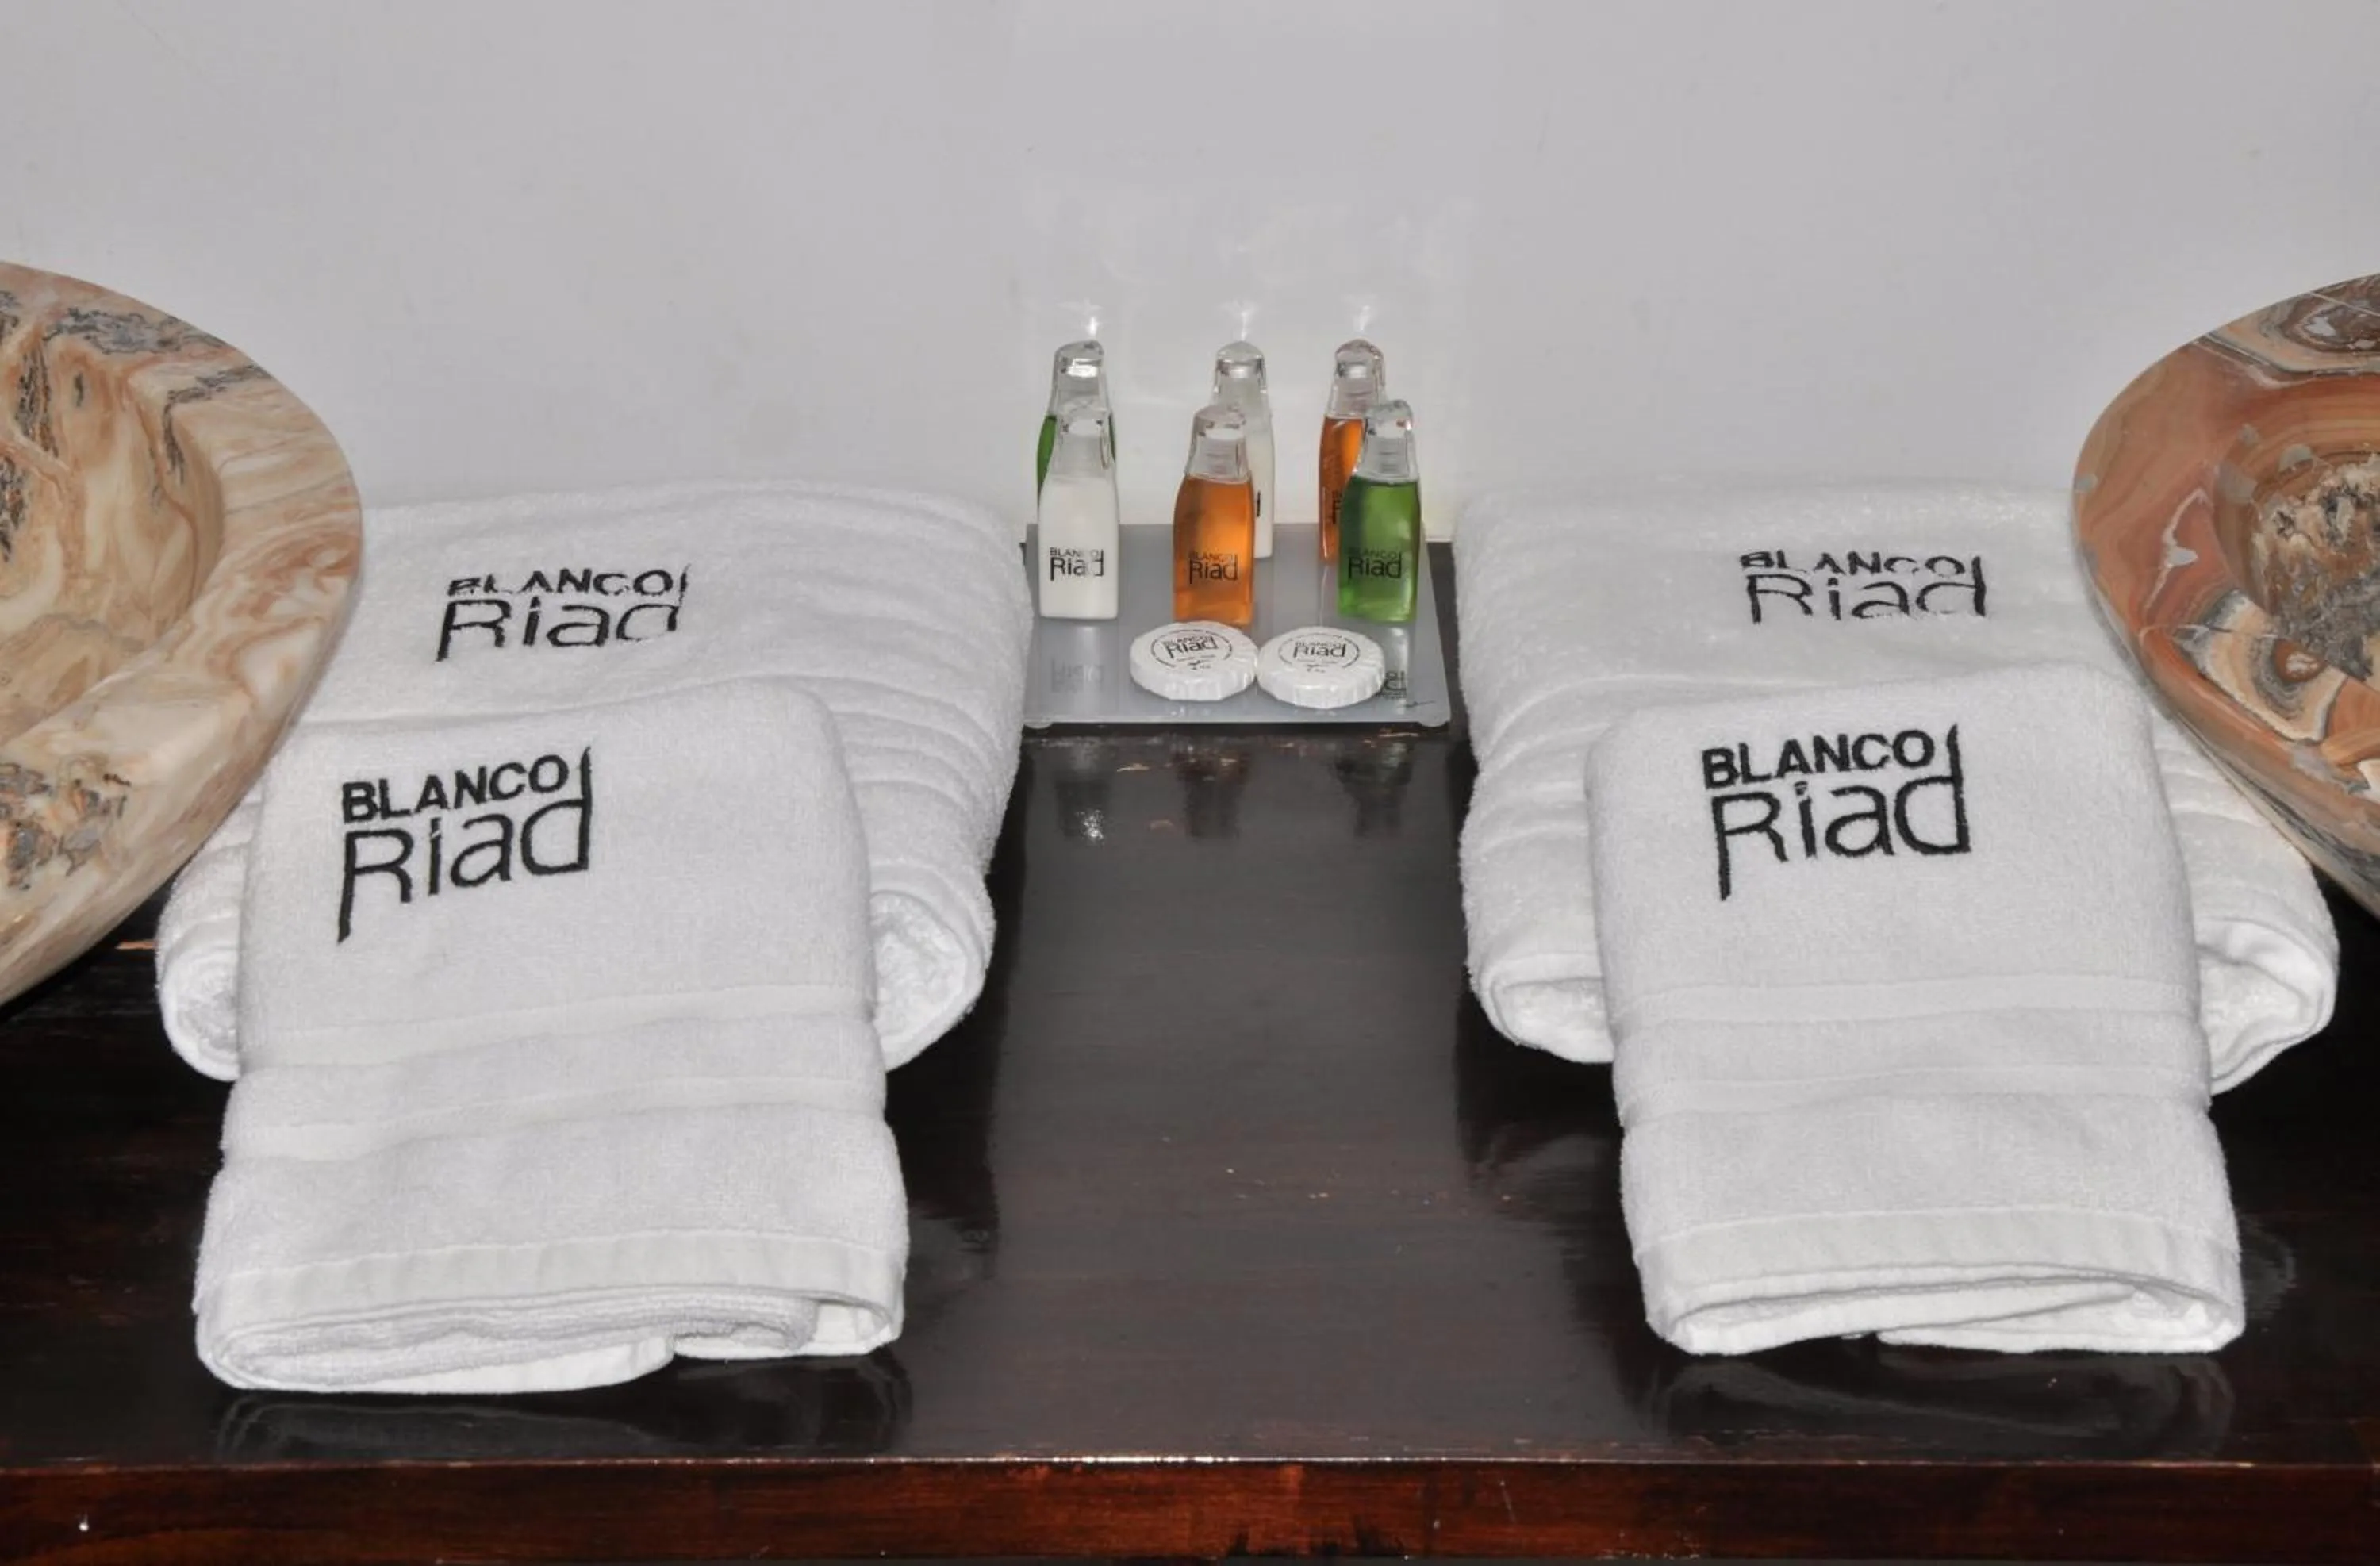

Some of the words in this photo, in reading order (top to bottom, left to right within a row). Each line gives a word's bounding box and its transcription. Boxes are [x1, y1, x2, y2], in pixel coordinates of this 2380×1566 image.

[1050, 547, 1099, 558] BLANO
[1189, 551, 1233, 561] BLAN
[1189, 554, 1238, 585] Riad
[1348, 552, 1402, 581] Riad
[1740, 550, 1966, 576] BLANCO
[447, 568, 674, 597] BLANCO
[1746, 555, 1987, 624] Riad
[436, 563, 693, 662] Riad
[1702, 729, 1935, 789] BLANCO
[342, 754, 570, 823] BLANCO
[1710, 722, 1971, 901] Riad
[337, 745, 593, 945] Riad
